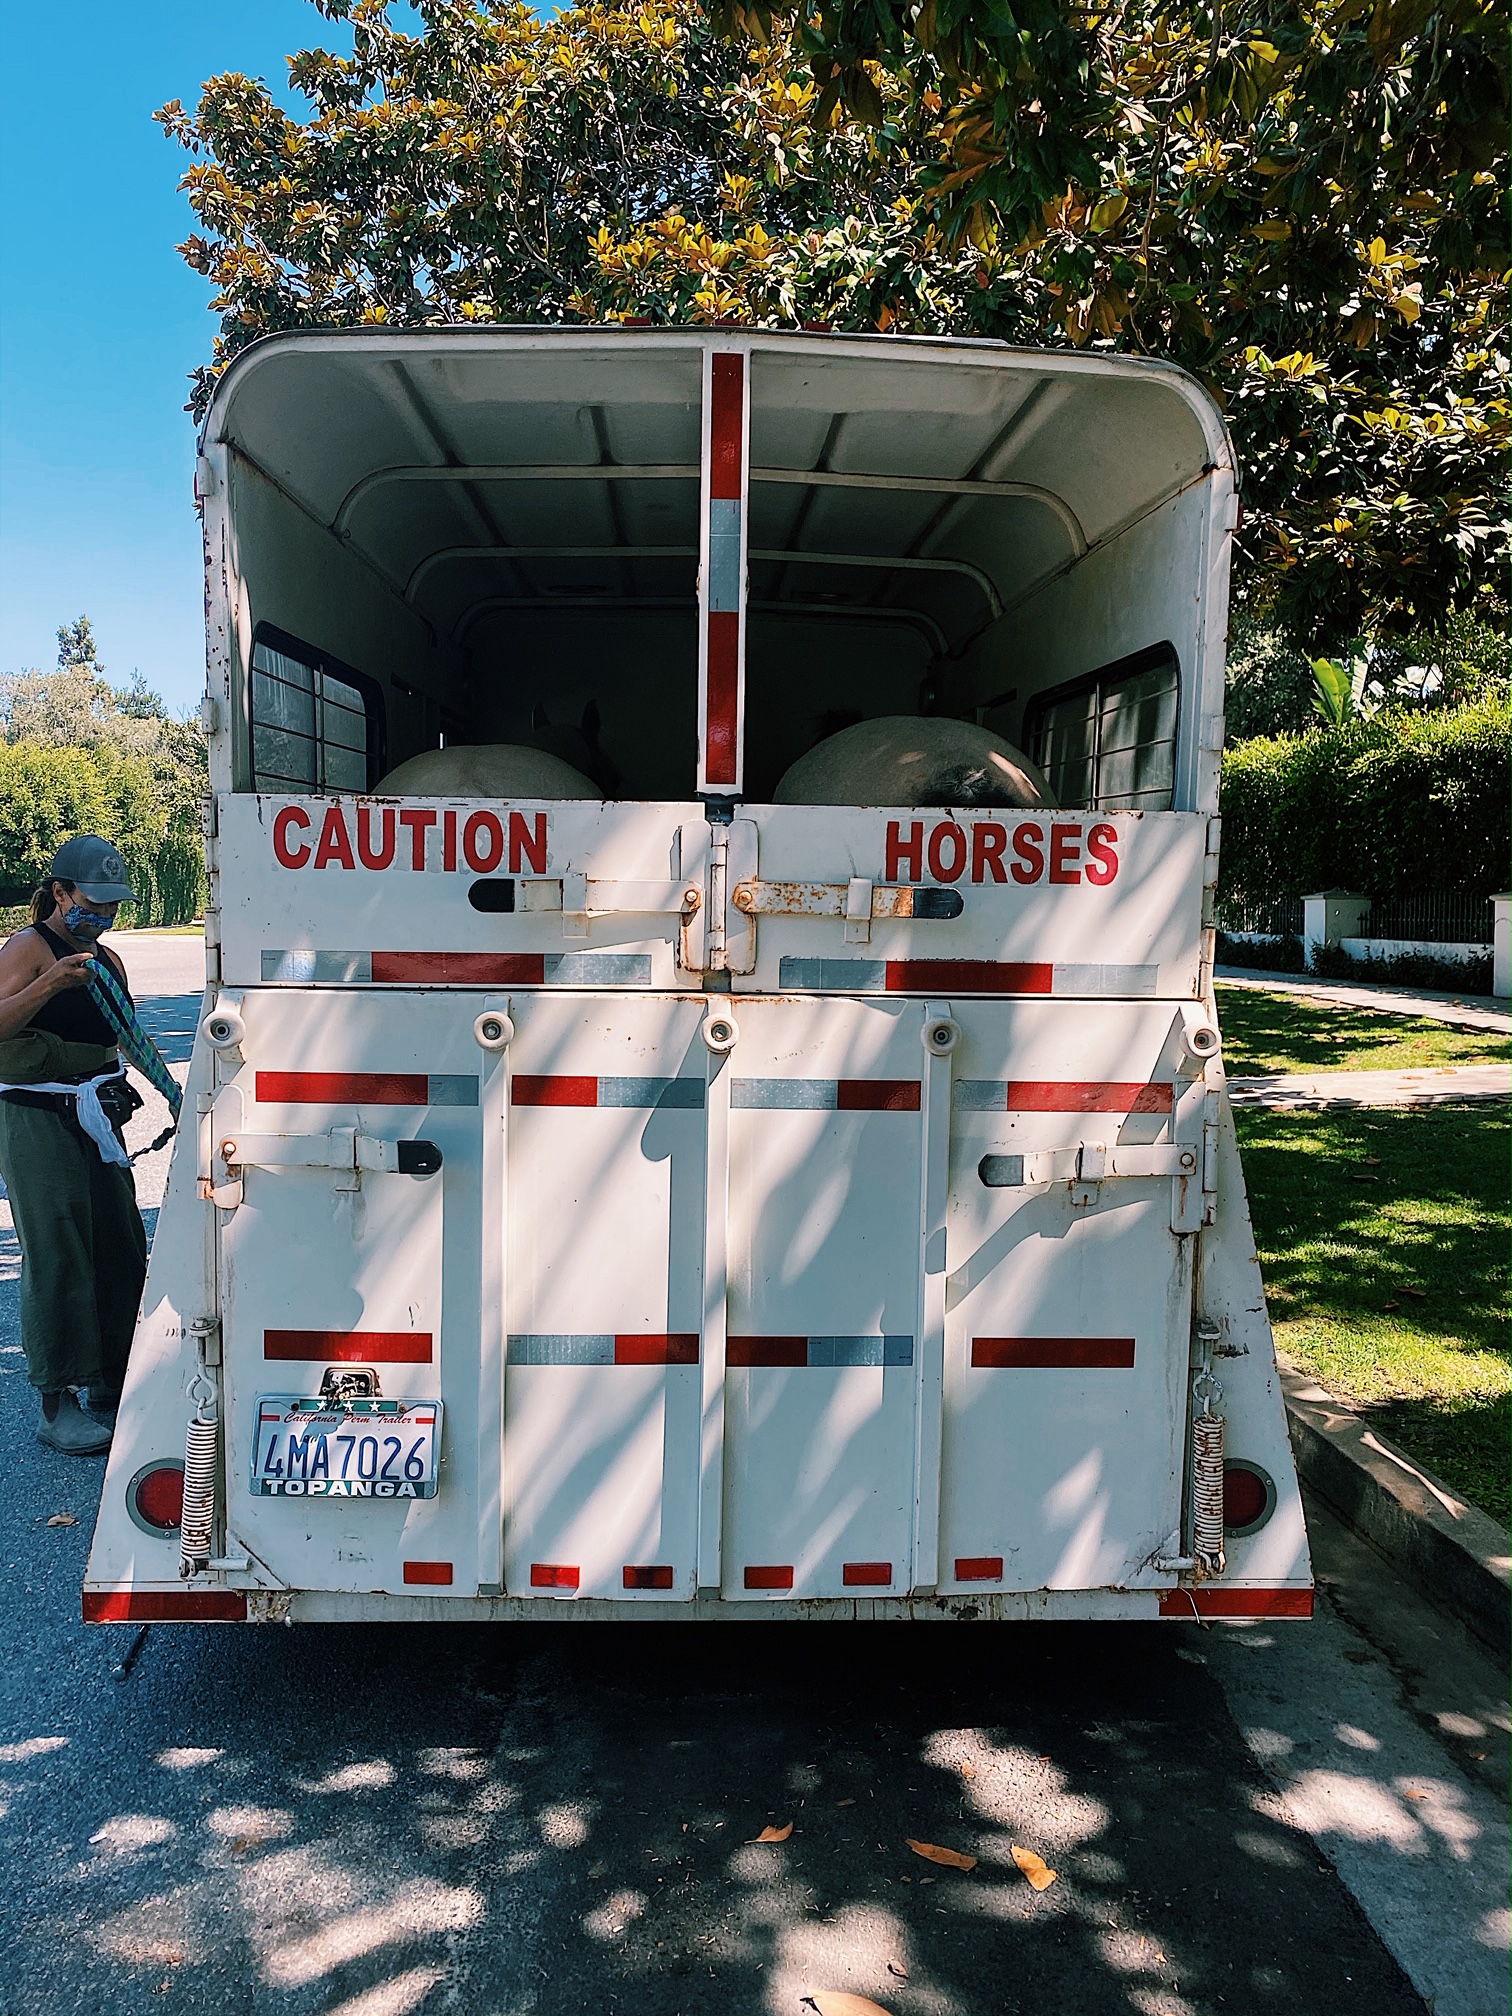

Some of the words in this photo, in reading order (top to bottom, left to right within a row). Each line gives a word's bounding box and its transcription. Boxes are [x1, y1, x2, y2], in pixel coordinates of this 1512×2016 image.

[273, 806, 547, 874] CAUTION
[886, 821, 1118, 886] HORSES
[285, 1413, 337, 1424] California
[343, 1413, 370, 1424] Perm
[376, 1413, 412, 1424] Trailer
[264, 1434, 425, 1480] 4MA7026
[266, 1481, 417, 1497] TOPANGA
